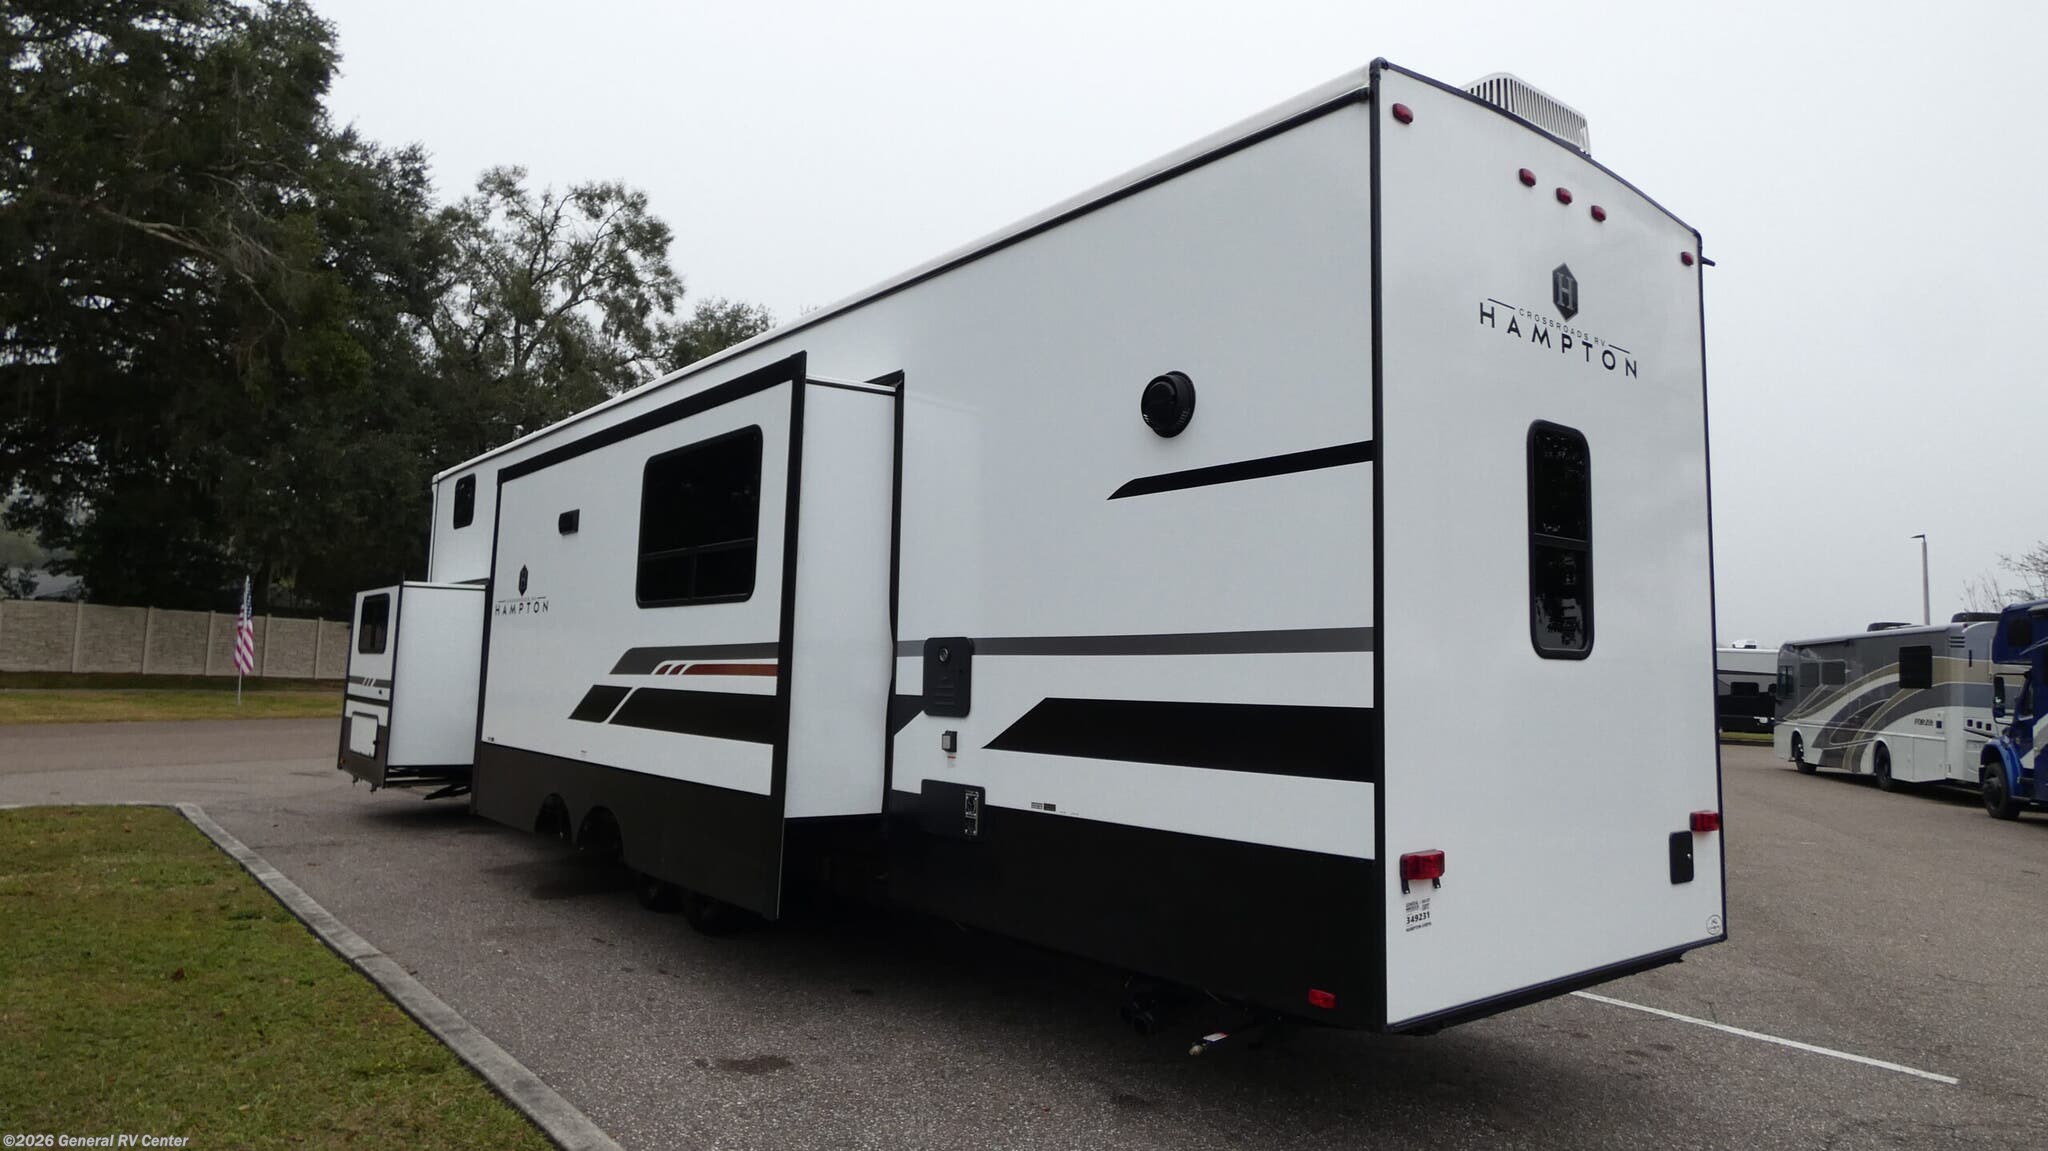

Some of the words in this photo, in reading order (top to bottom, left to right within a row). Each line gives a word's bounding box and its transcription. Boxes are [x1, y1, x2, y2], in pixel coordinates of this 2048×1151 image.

[1556, 271, 1575, 310] H
[1479, 302, 1638, 379] HAMPTON
[1518, 308, 1589, 340] CROSSROADS
[1594, 336, 1607, 347] RV
[494, 600, 549, 616] HAMPTON
[1406, 911, 1430, 924] 349231
